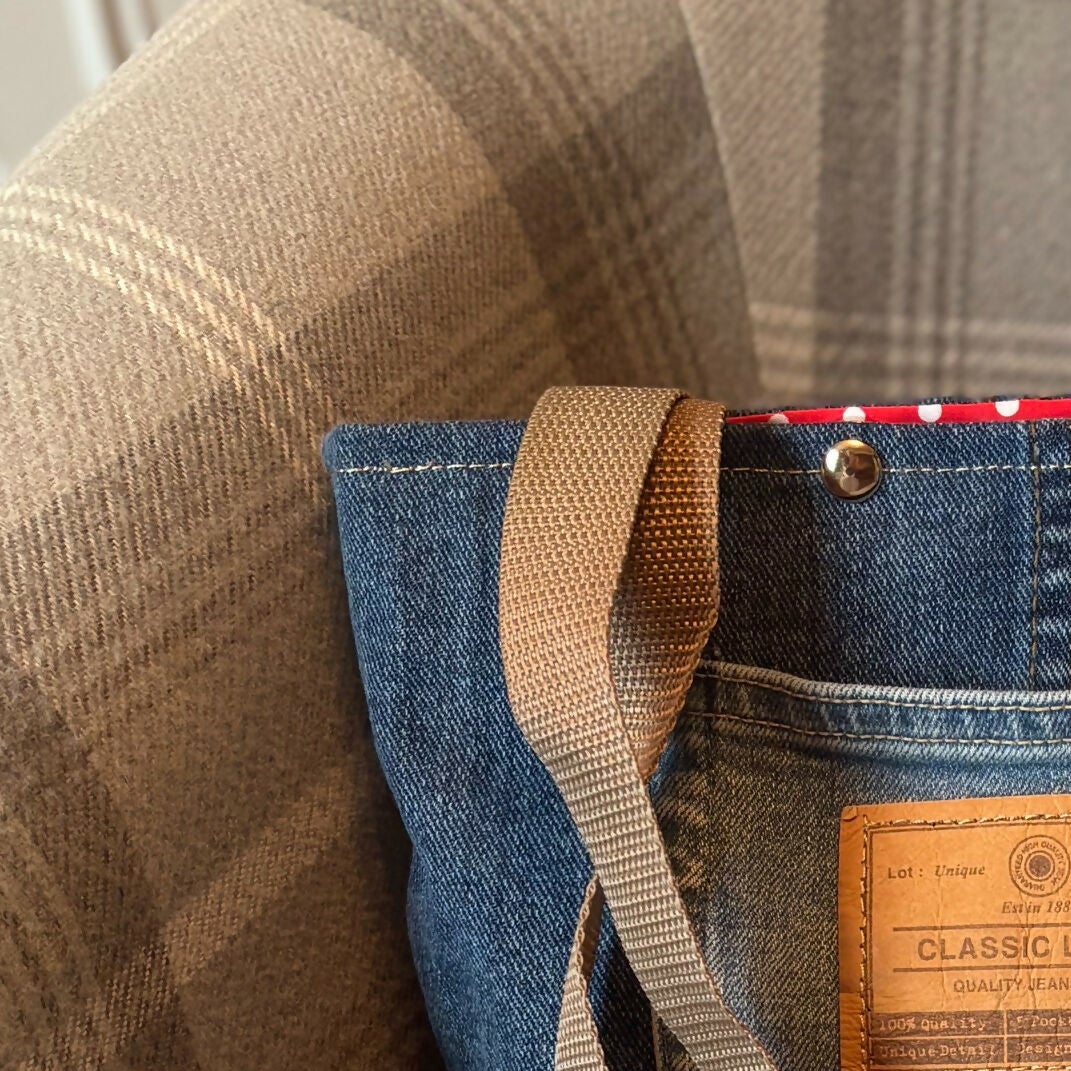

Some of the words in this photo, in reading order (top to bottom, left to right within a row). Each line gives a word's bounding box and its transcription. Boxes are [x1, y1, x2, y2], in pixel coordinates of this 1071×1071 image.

[935, 864, 985, 880] Unique
[917, 935, 1050, 961] CLASSIC
[953, 978, 1023, 993] QUALITY
[920, 1017, 987, 1031] Quality
